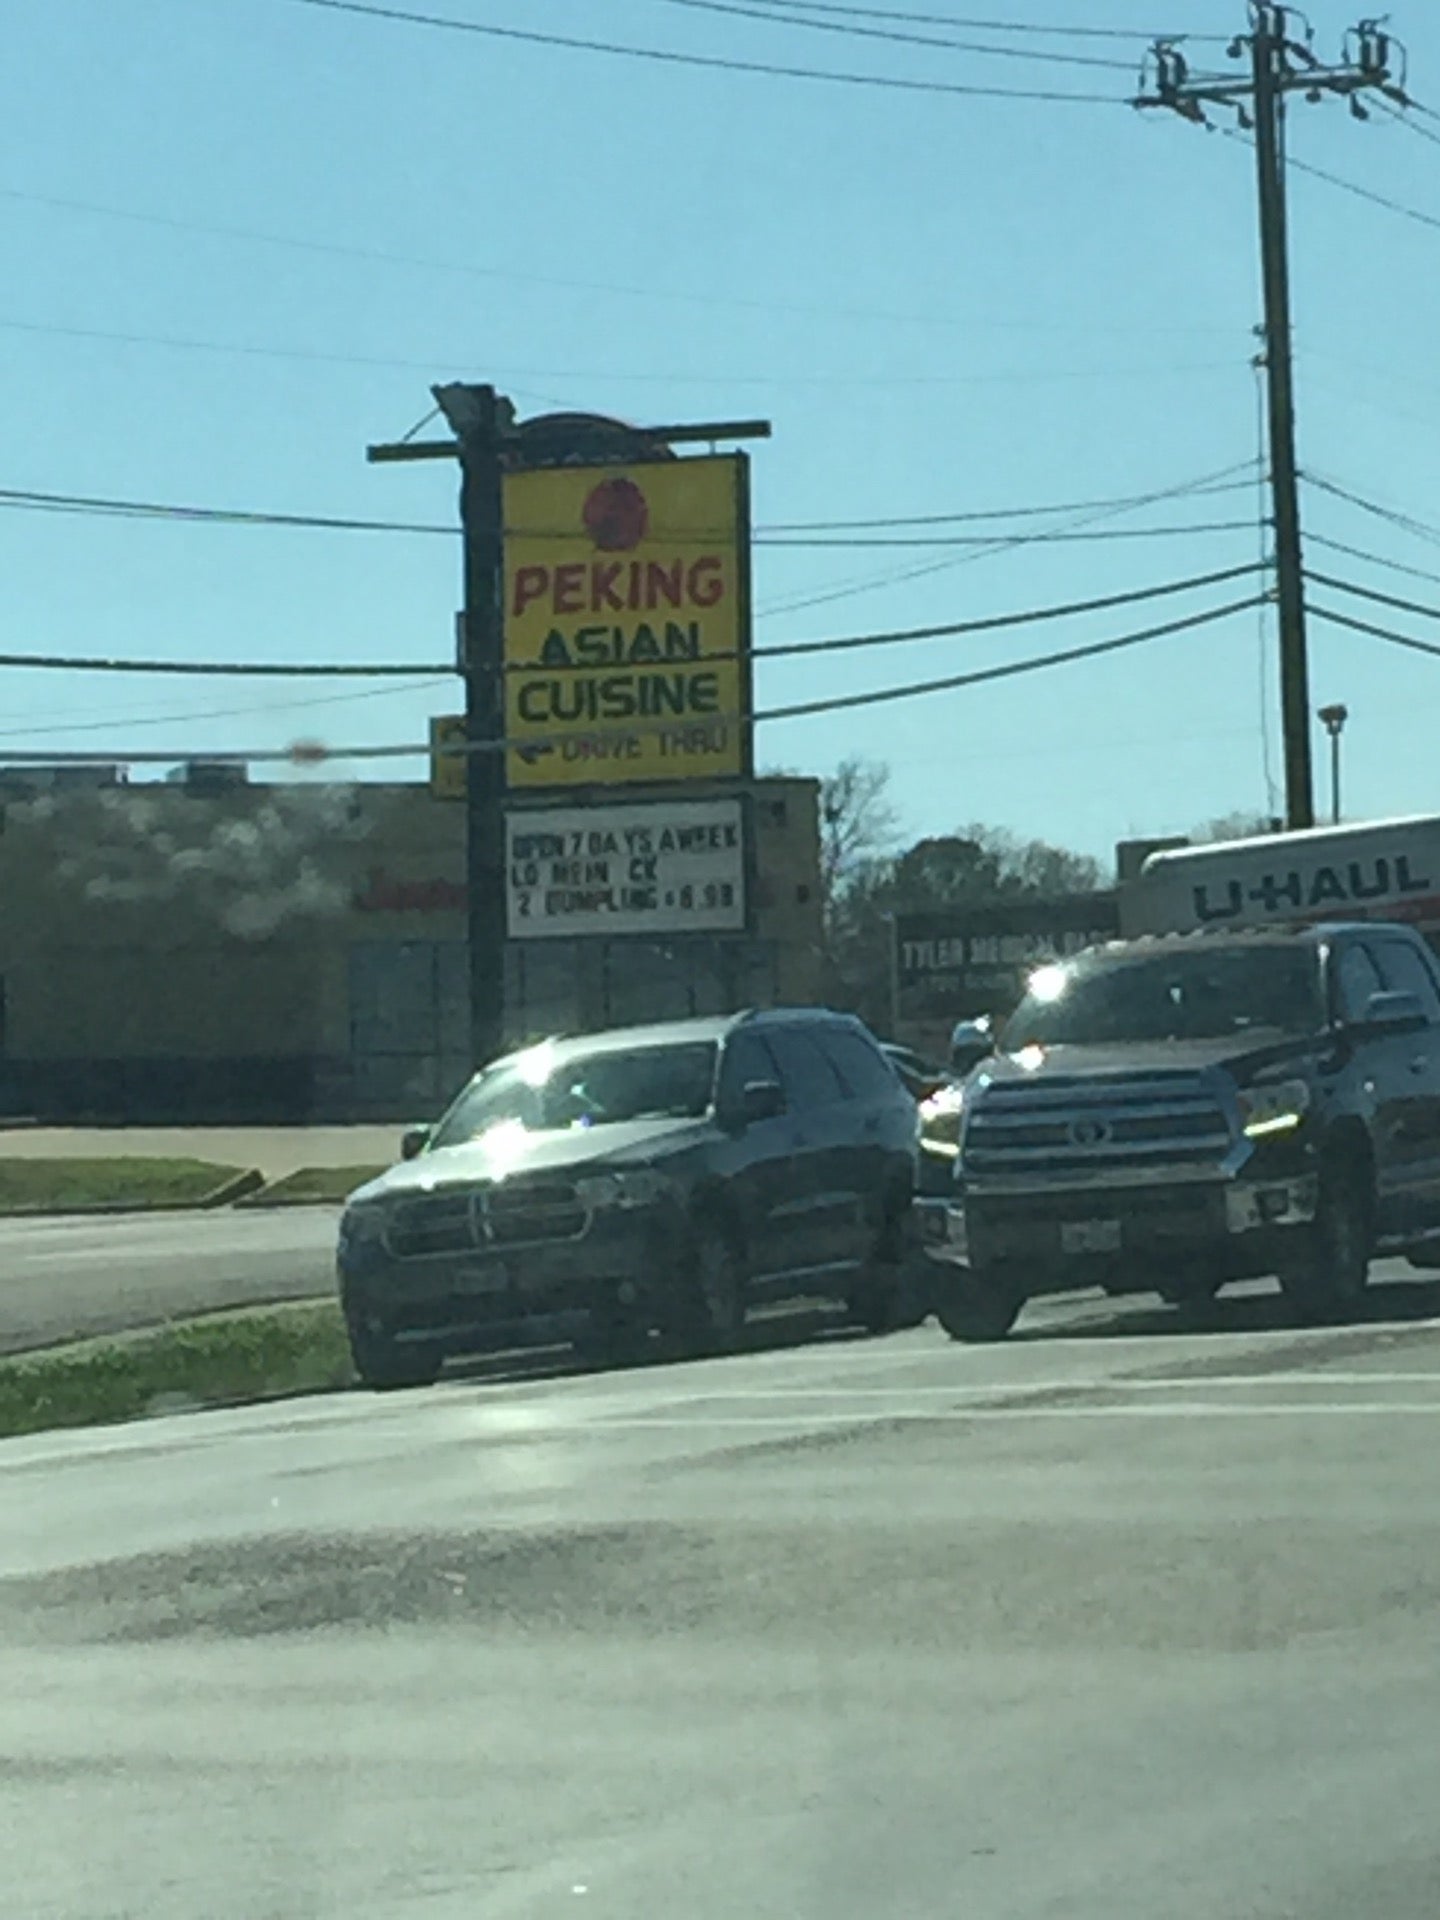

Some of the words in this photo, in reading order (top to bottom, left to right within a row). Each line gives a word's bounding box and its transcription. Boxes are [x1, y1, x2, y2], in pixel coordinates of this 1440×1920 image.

[512, 556, 723, 617] PEKING
[540, 621, 699, 663] ASIAN
[517, 672, 720, 722] CUISINE
[658, 725, 728, 757] THRU
[571, 832, 583, 853] 7
[588, 827, 652, 853] DAYS
[659, 828, 676, 851] A
[678, 822, 738, 849] WEEK
[512, 861, 539, 887] LO
[629, 856, 657, 882] CK
[1193, 856, 1430, 921] U-HAUL
